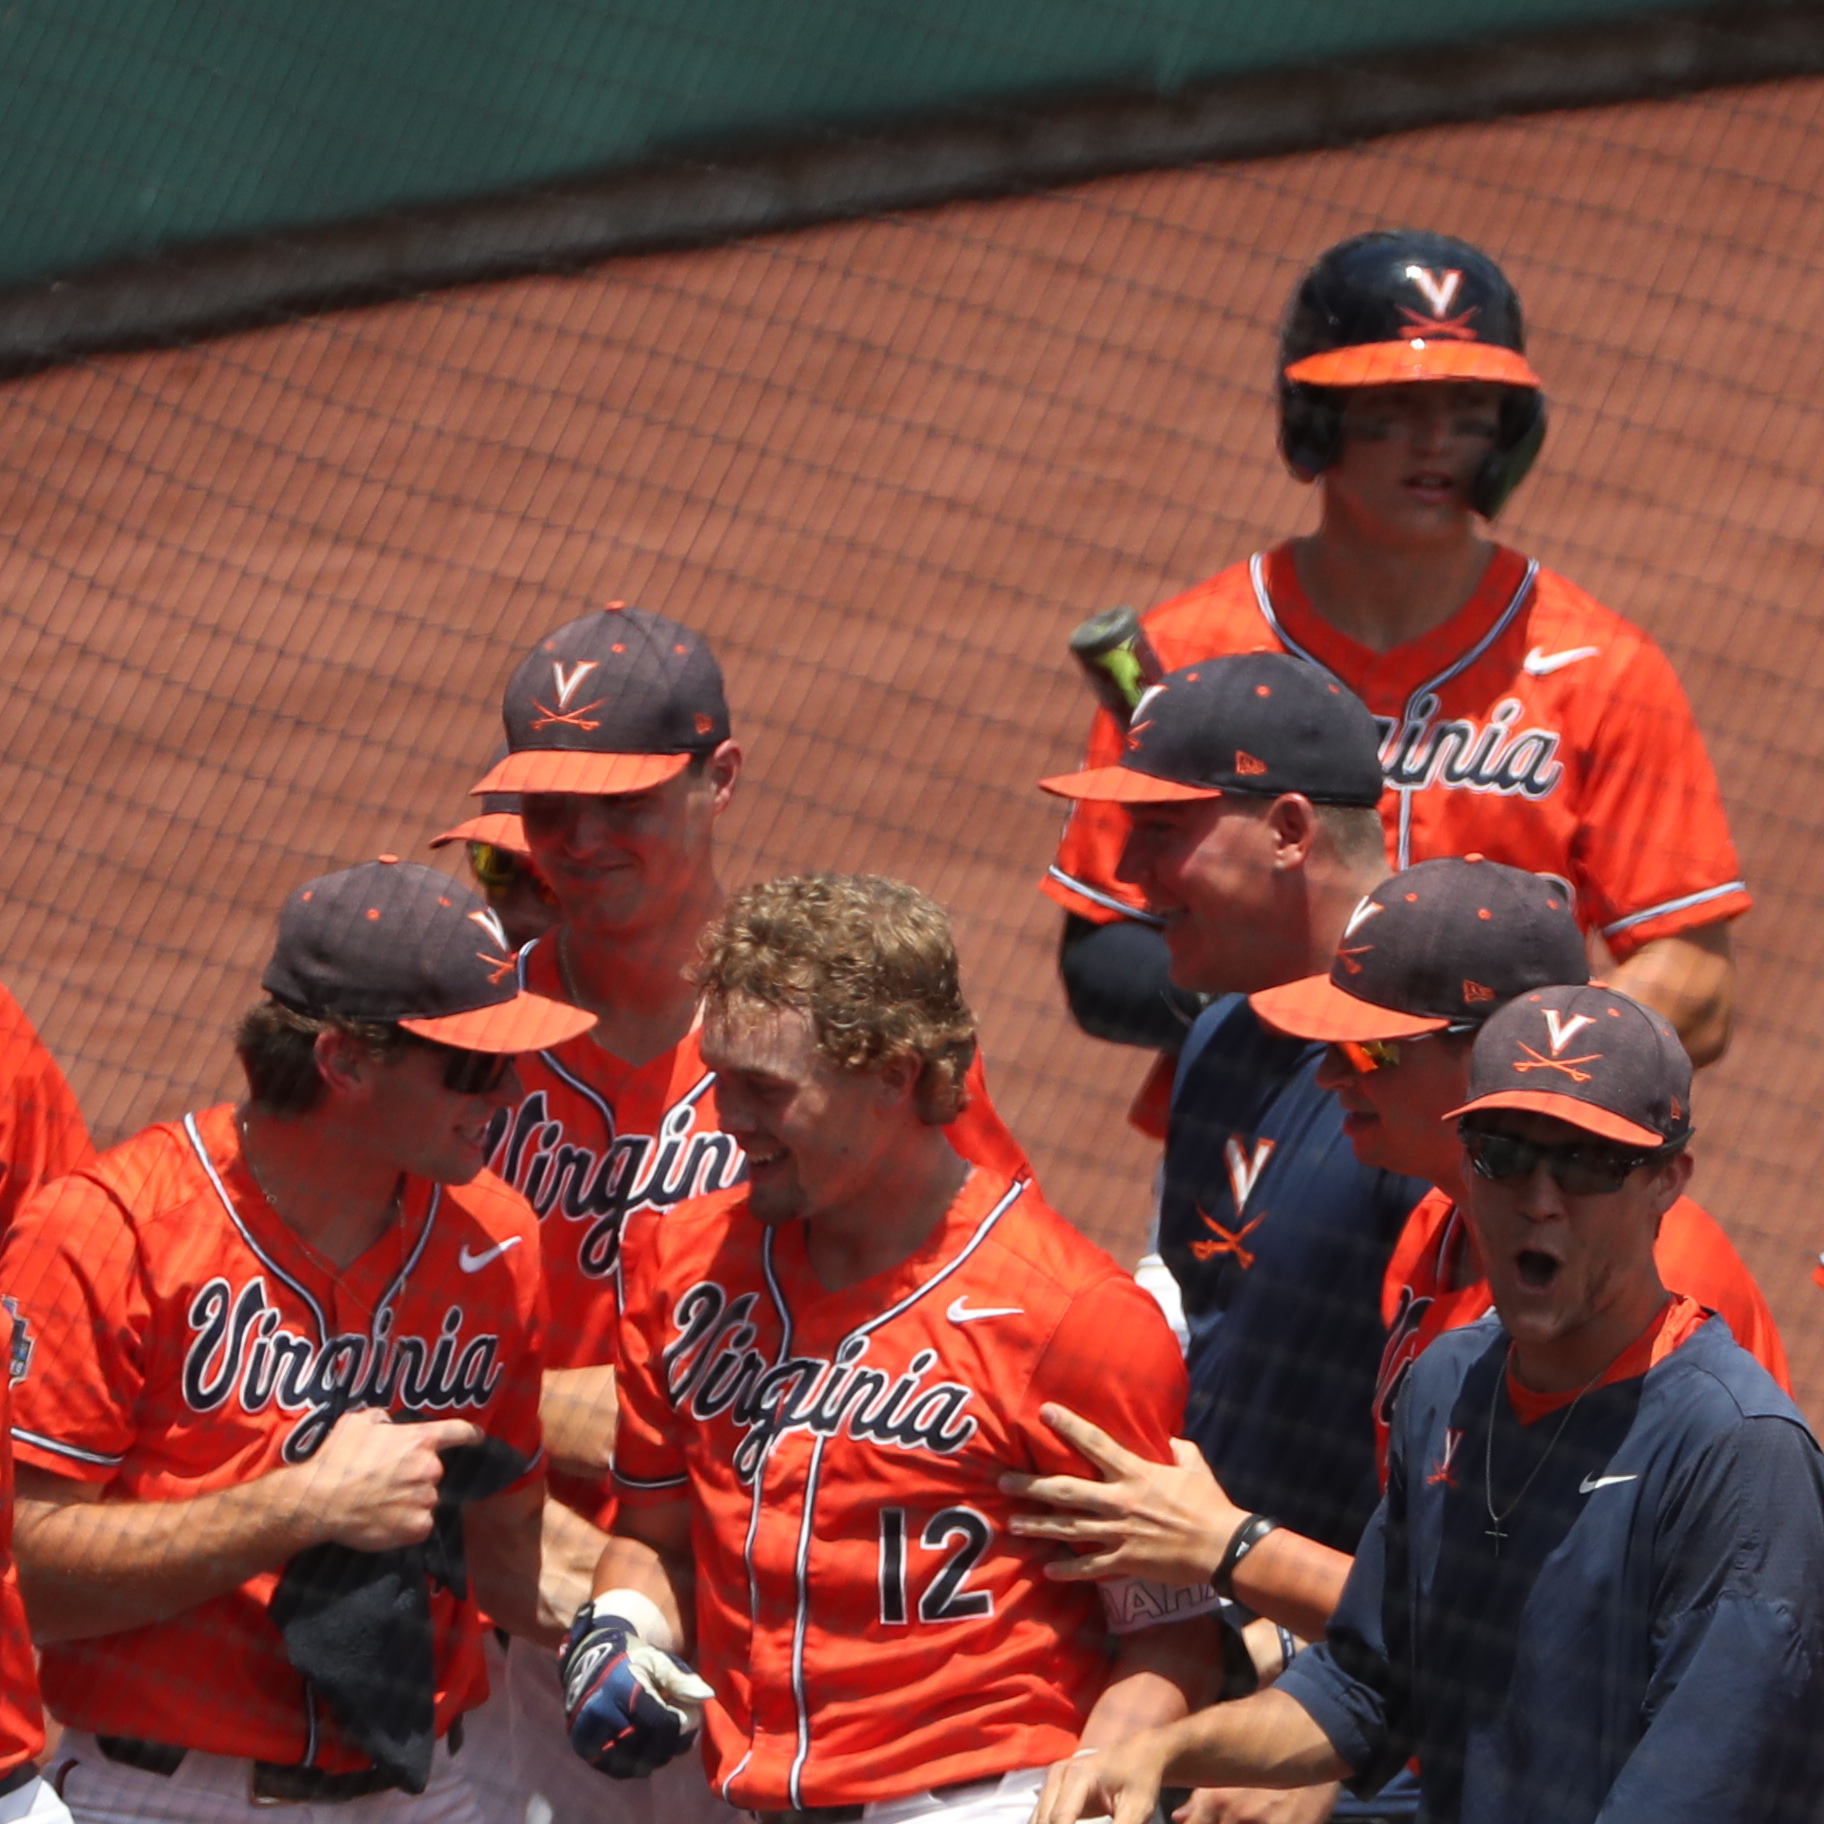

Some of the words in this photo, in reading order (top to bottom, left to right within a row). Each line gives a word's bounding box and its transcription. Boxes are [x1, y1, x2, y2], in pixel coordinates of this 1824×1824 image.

[183, 1277, 502, 1463] Virginia
[664, 1281, 976, 1484] Virginia
[878, 1507, 995, 1625] 12
